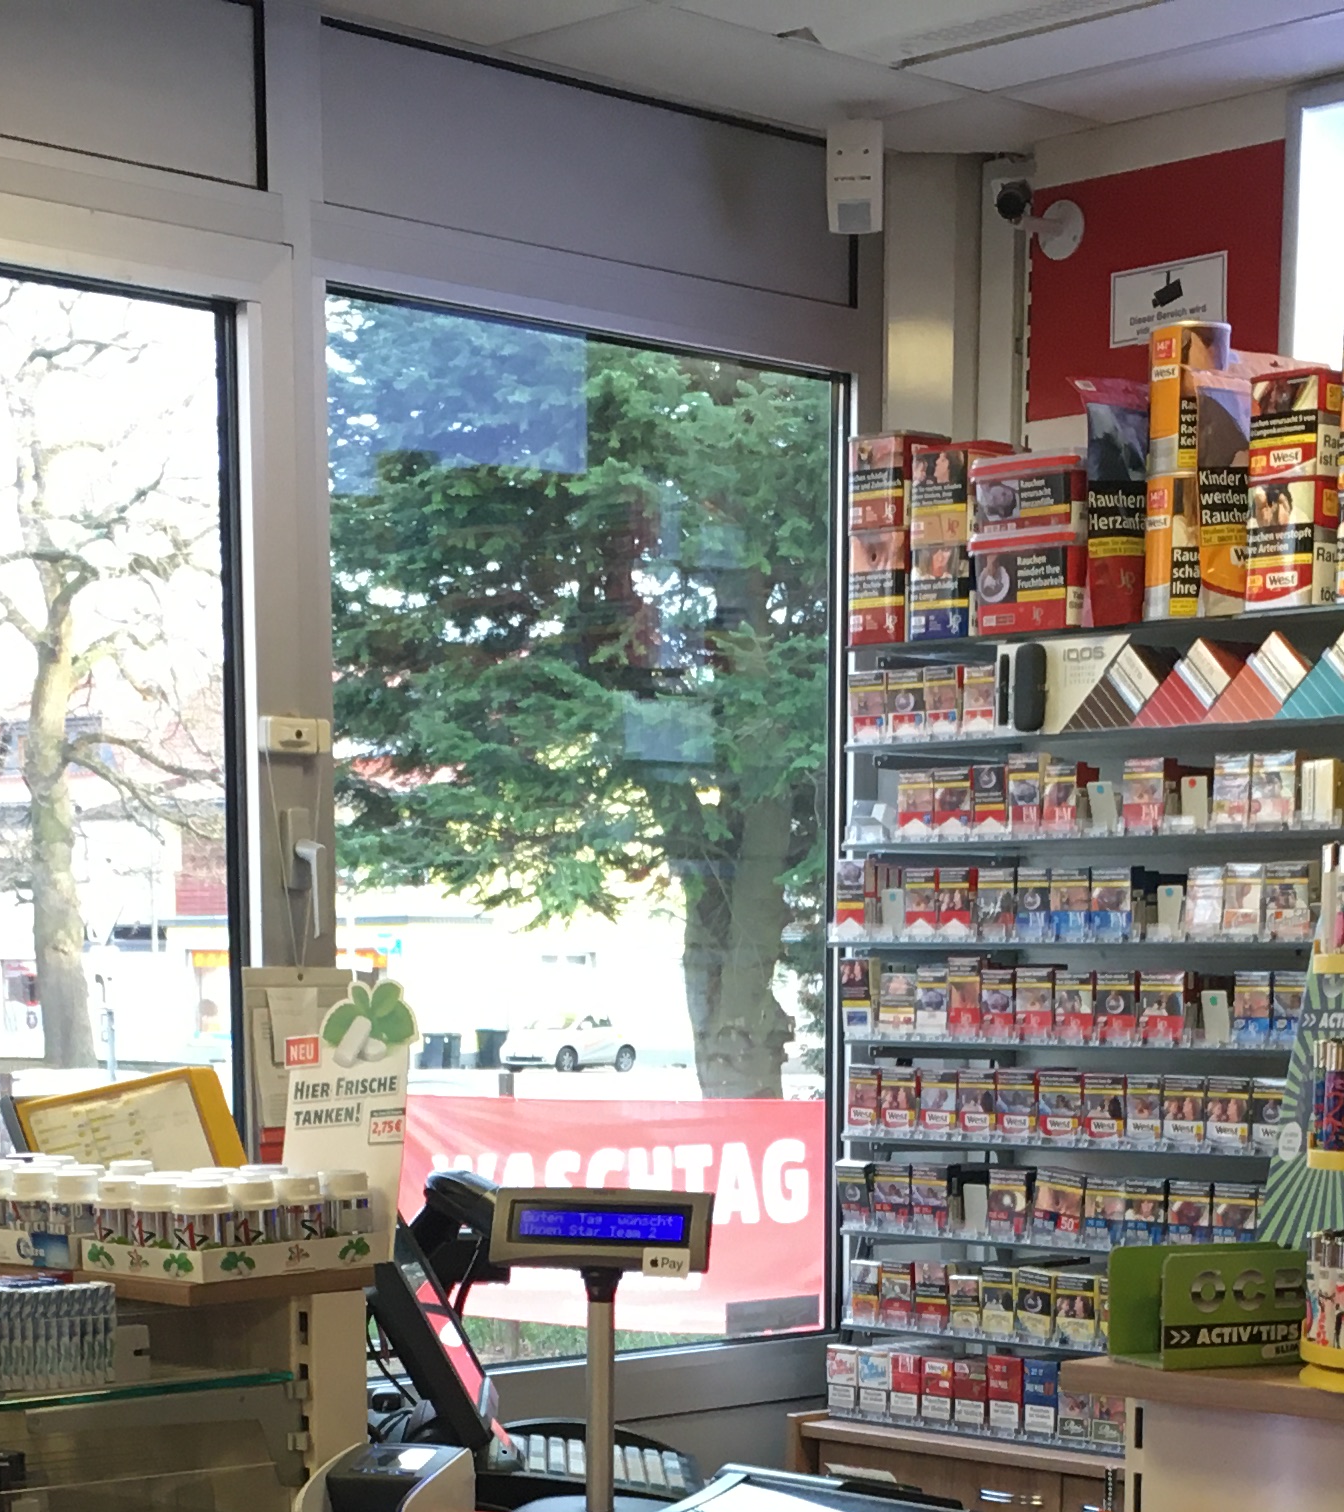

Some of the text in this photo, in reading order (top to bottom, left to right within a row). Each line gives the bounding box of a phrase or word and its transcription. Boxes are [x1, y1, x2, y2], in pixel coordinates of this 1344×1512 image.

[1130, 313, 1154, 326] Dieser
[1273, 450, 1299, 463] West
[1199, 470, 1240, 486] Kinder
[1087, 491, 1145, 509] Rauchen
[1200, 490, 1247, 505] werden
[1273, 527, 1312, 540] verstopft
[1258, 542, 1289, 554] Arterien
[1017, 556, 1046, 566] Rauchen
[1269, 573, 1296, 585] West
[1062, 645, 1105, 664] IQOS
[288, 1041, 315, 1064] NEU
[292, 1073, 398, 1101] HIER FRISCHE
[293, 1103, 362, 1127] TANKEN!
[371, 1118, 403, 1135] 2,75€
[569, 1225, 600, 1235] Star
[610, 1227, 641, 1237] Team
[648, 1228, 656, 1238] 2
[661, 1257, 683, 1271] Pay
[1196, 1322, 1299, 1345] ACTIV'TIPS
